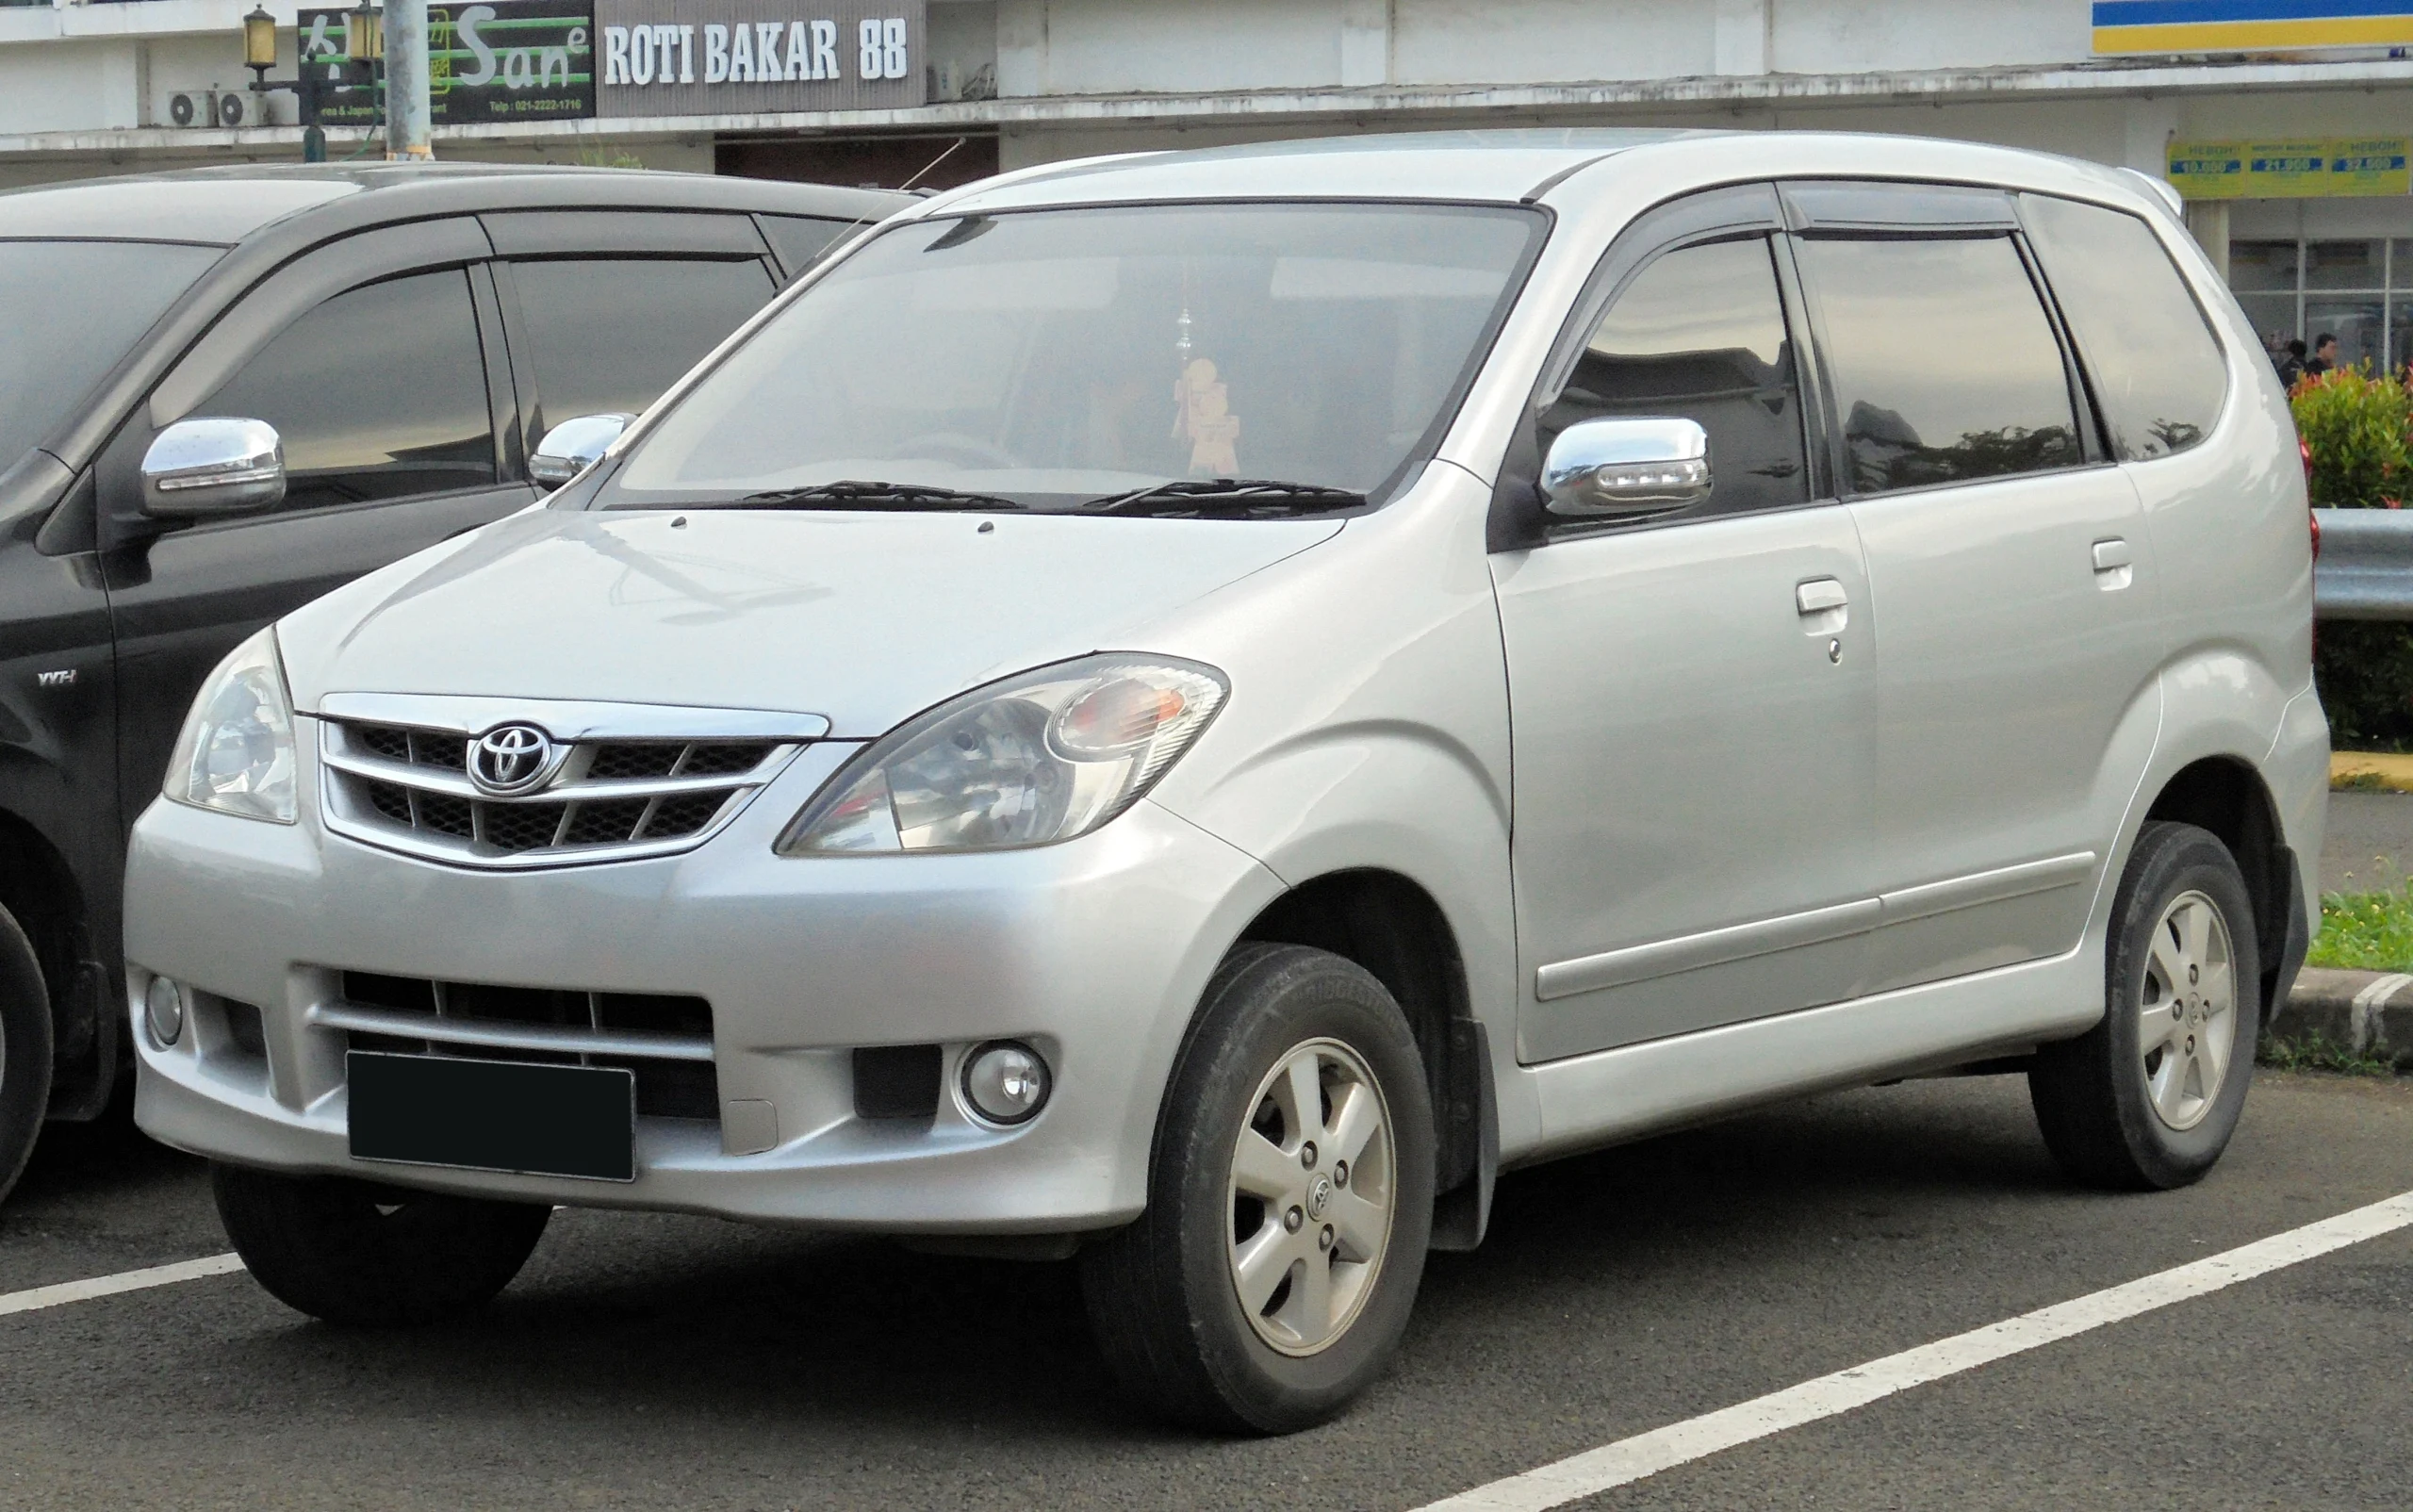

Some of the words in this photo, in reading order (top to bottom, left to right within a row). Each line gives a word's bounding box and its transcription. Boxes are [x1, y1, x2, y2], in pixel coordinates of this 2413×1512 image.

[604, 25, 695, 86] ROTI
[704, 20, 841, 84] BAKAR
[859, 18, 908, 80] 88
[515, 99, 583, 111] 021-2222-1716
